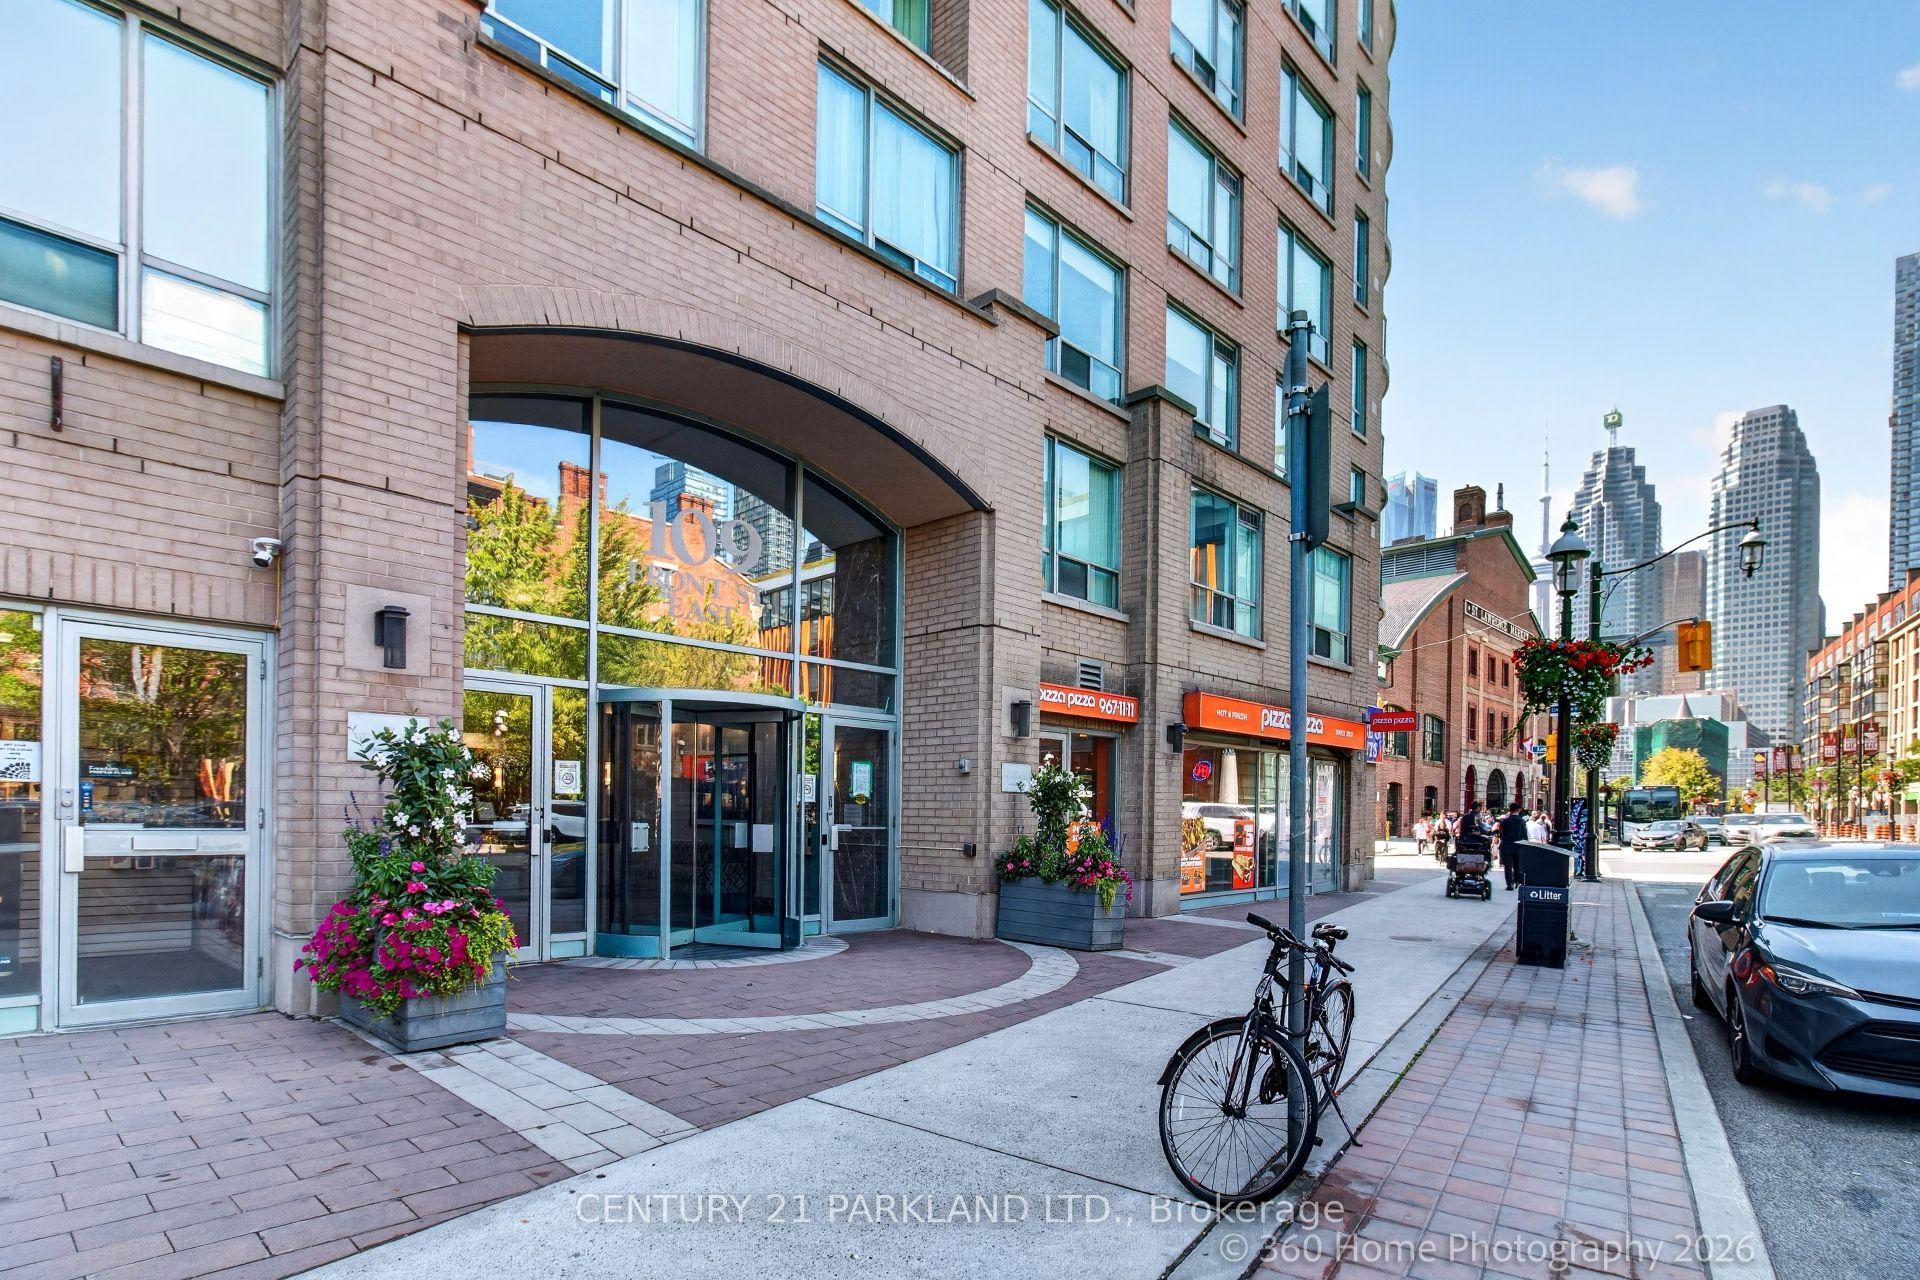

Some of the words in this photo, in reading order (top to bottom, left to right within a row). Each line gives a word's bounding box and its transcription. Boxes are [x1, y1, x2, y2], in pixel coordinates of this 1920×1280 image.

[1606, 414, 1618, 423] TD
[644, 501, 763, 574] 109
[629, 559, 727, 599] FRONT
[669, 597, 737, 627] EAST
[1068, 692, 1095, 709] pizza
[1216, 709, 1227, 717] HOT
[1394, 717, 1414, 725] pizza
[1306, 716, 1324, 735] zza
[1539, 889, 1562, 900] Litter
